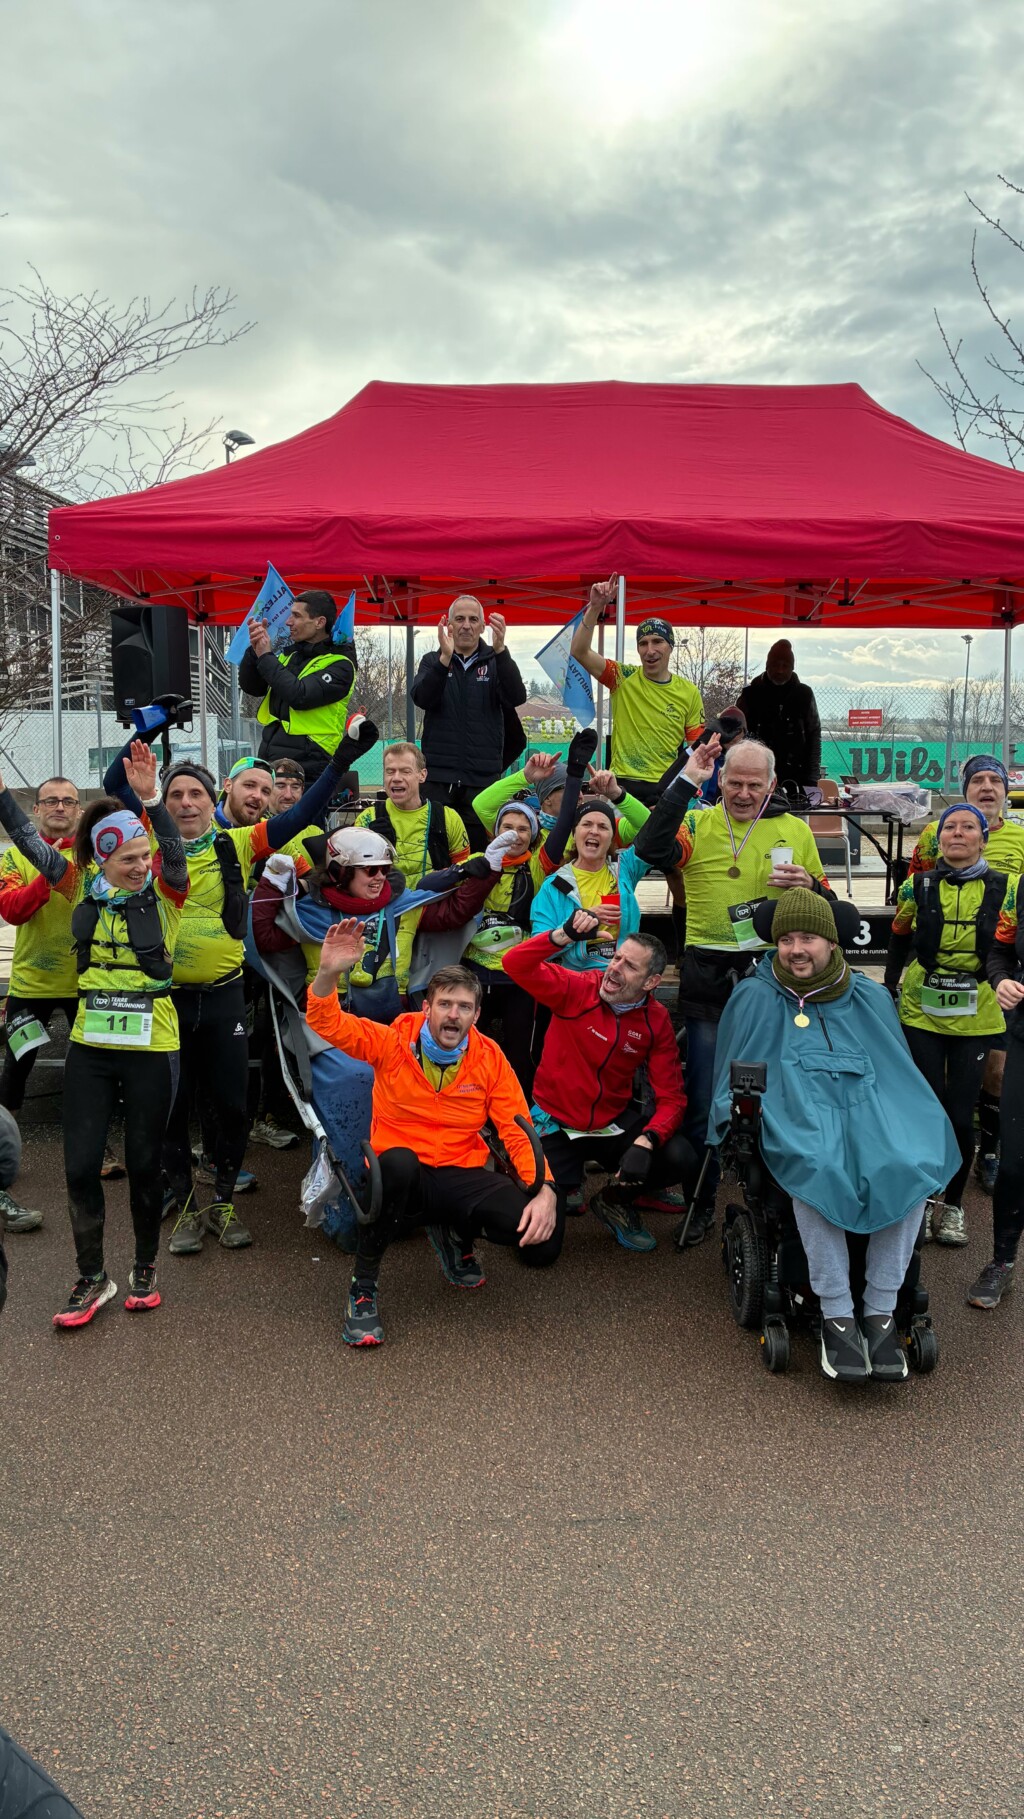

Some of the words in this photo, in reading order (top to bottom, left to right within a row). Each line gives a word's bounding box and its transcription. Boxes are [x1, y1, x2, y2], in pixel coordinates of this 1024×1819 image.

[491, 930, 502, 942] 3
[852, 920, 872, 946] 3
[937, 993, 959, 1007] 10
[106, 1014, 128, 1032] 11
[20, 1029, 29, 1041] 1
